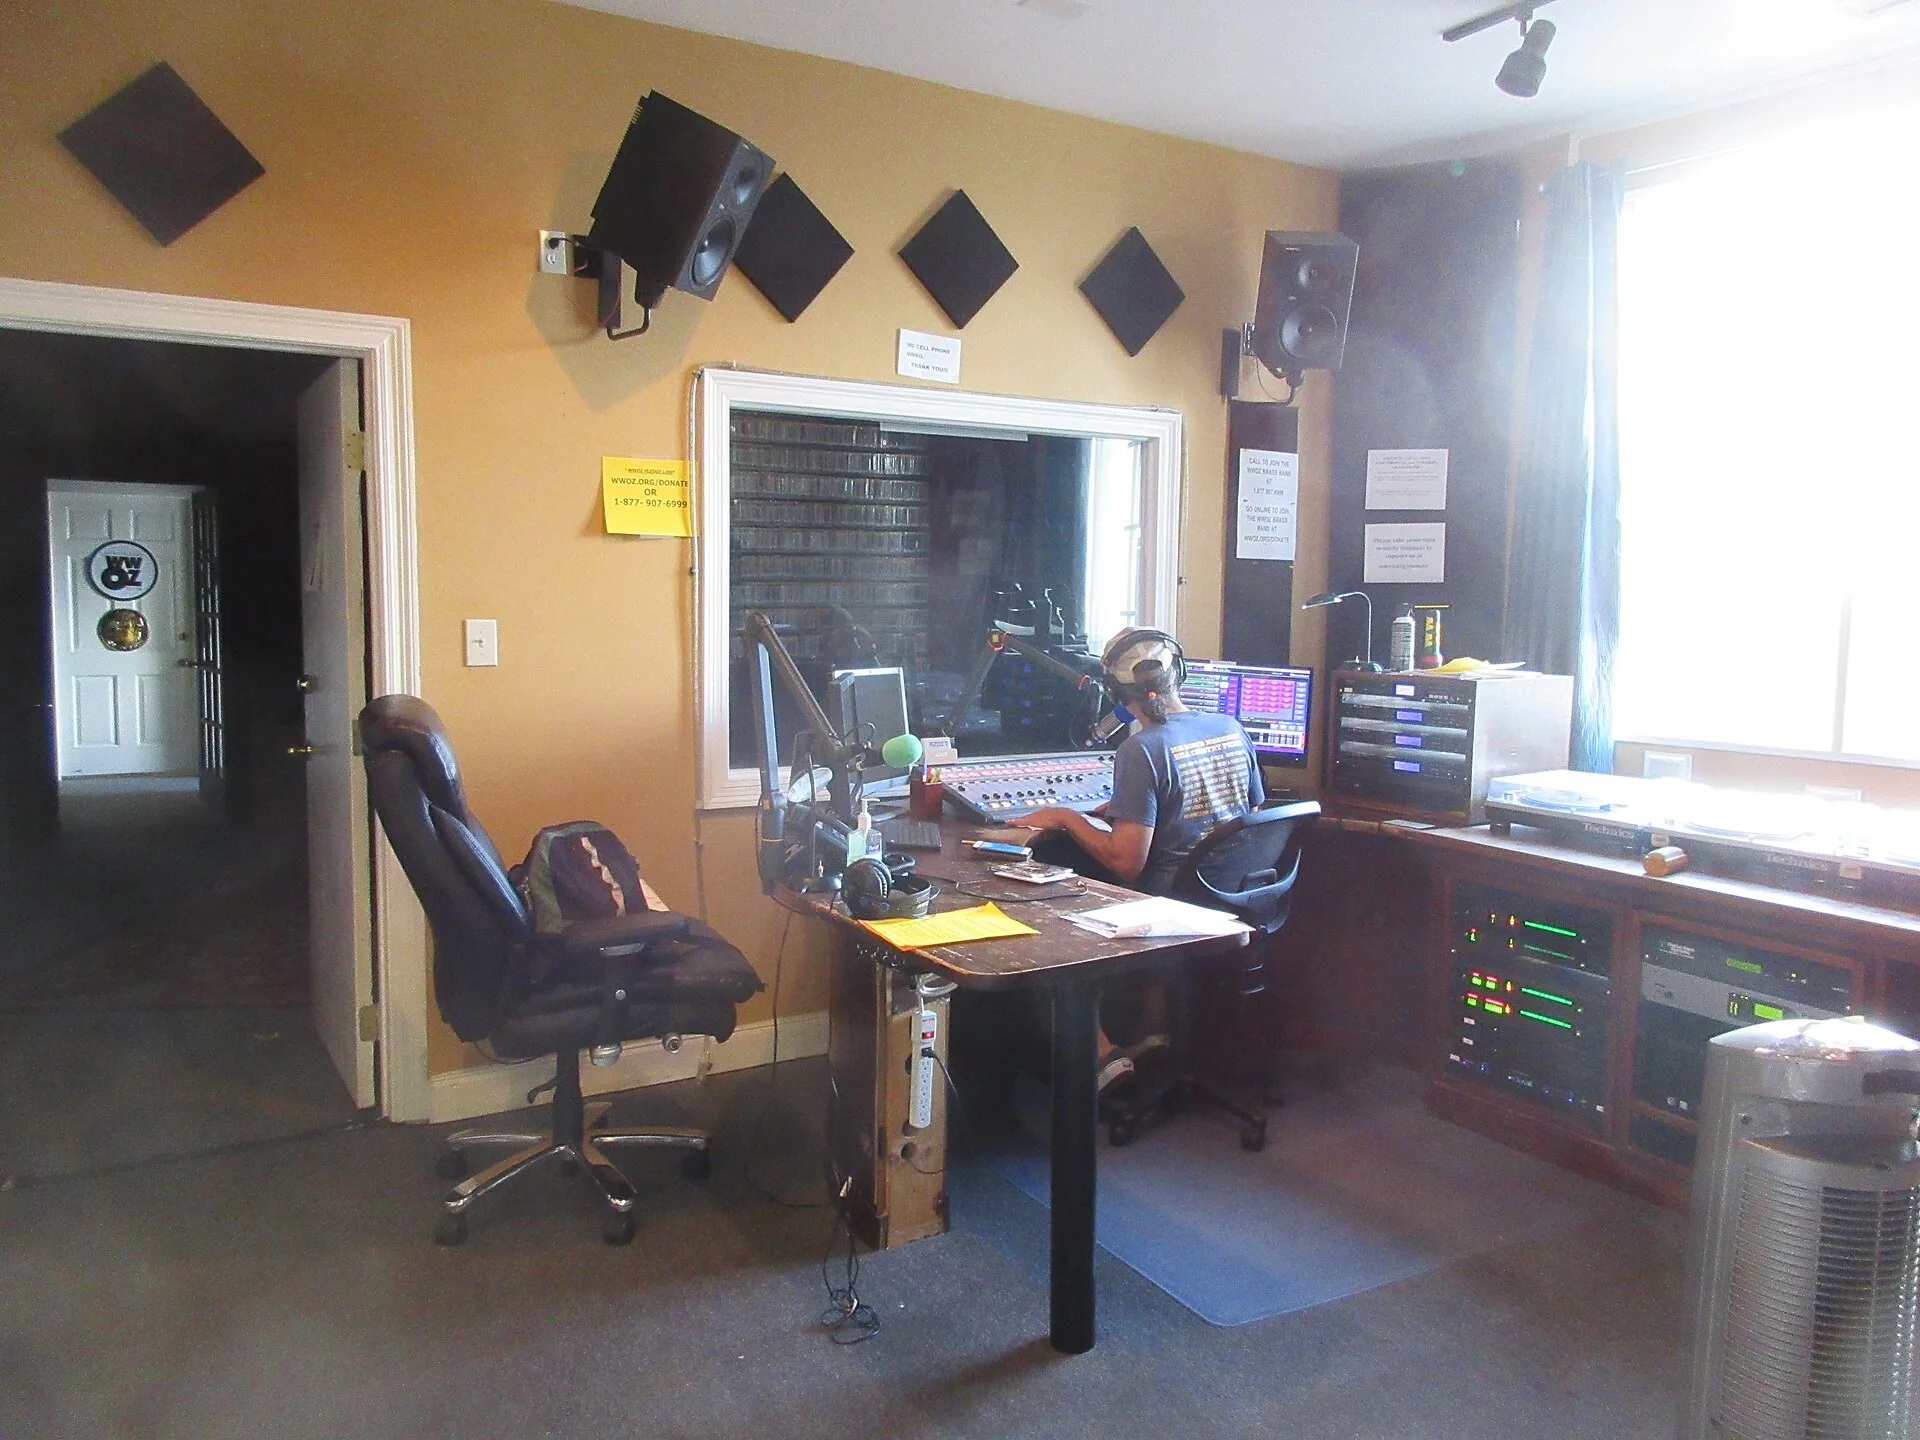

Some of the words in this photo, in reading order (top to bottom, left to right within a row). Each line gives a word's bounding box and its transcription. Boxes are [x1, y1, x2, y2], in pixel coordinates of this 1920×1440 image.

[911, 362, 930, 370] THANK
[611, 478, 688, 487] WWOZ.ORG/DONATE
[644, 488, 657, 496] OR
[1254, 506, 1271, 514] ONLINE
